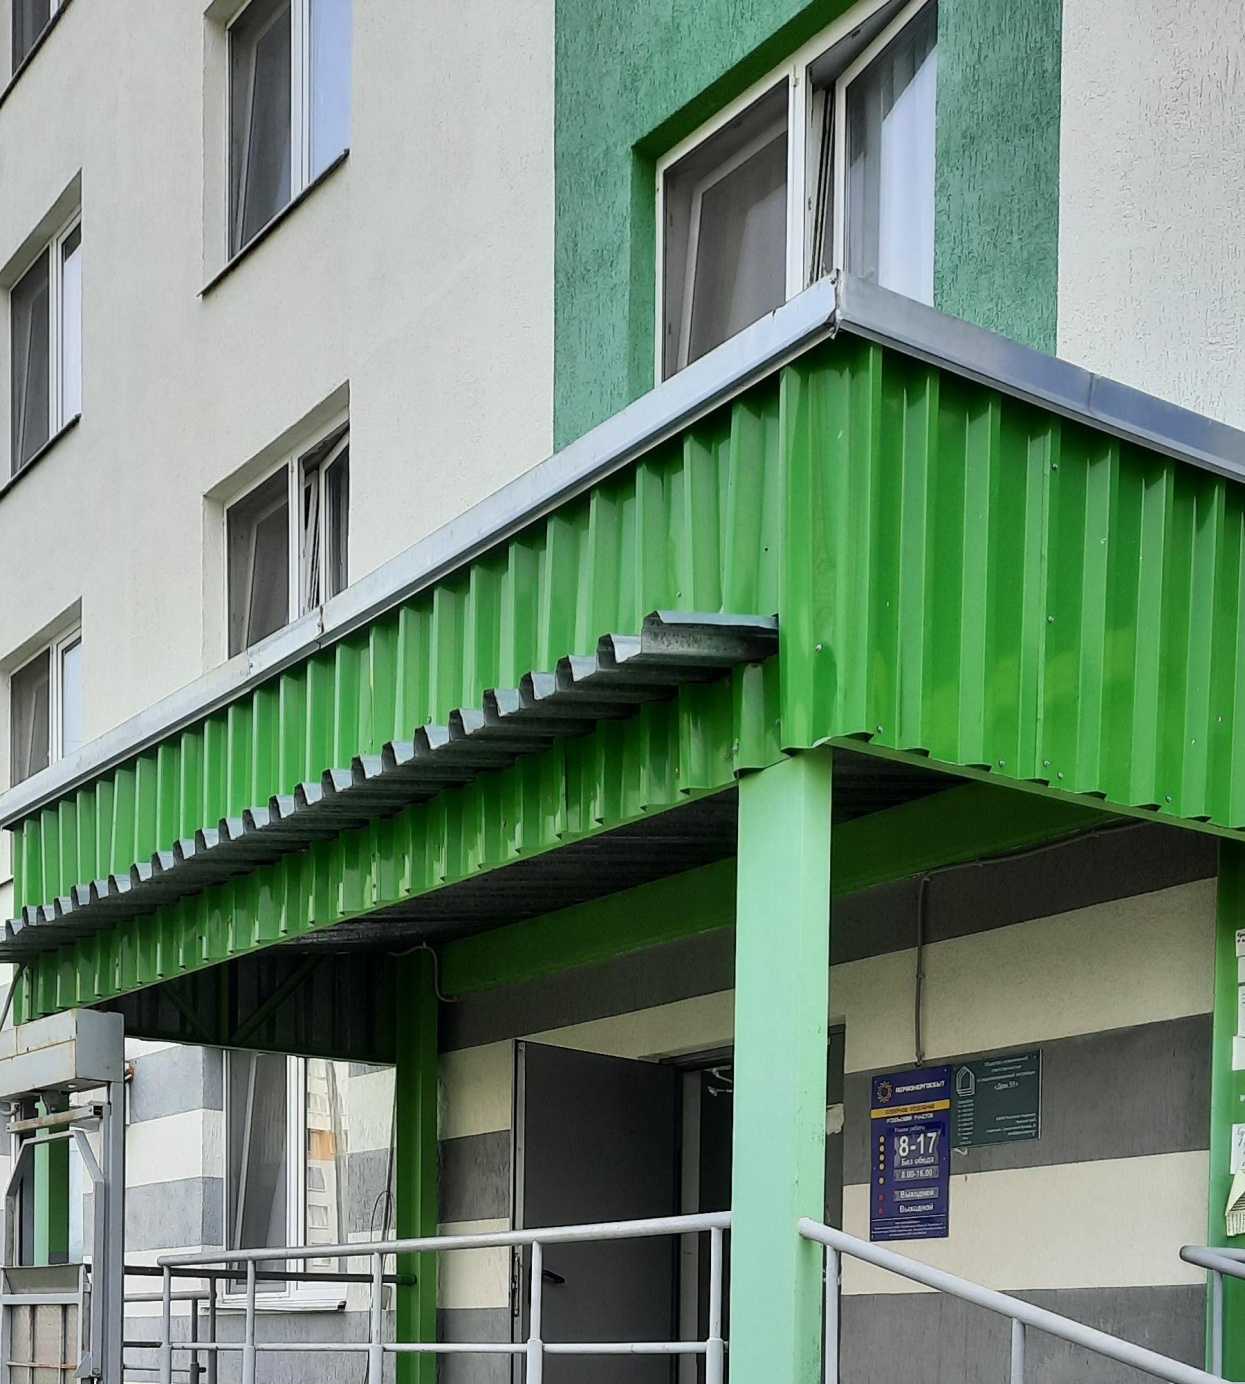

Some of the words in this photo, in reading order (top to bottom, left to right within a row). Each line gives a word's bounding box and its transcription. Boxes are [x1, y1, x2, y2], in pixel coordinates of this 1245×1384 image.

[899, 1131, 937, 1156] 8-17
[901, 1158, 913, 1166] Без
[914, 1156, 934, 1165] обеда
[900, 1189, 934, 1199] Выходной
[899, 1203, 934, 1213] Выходной
